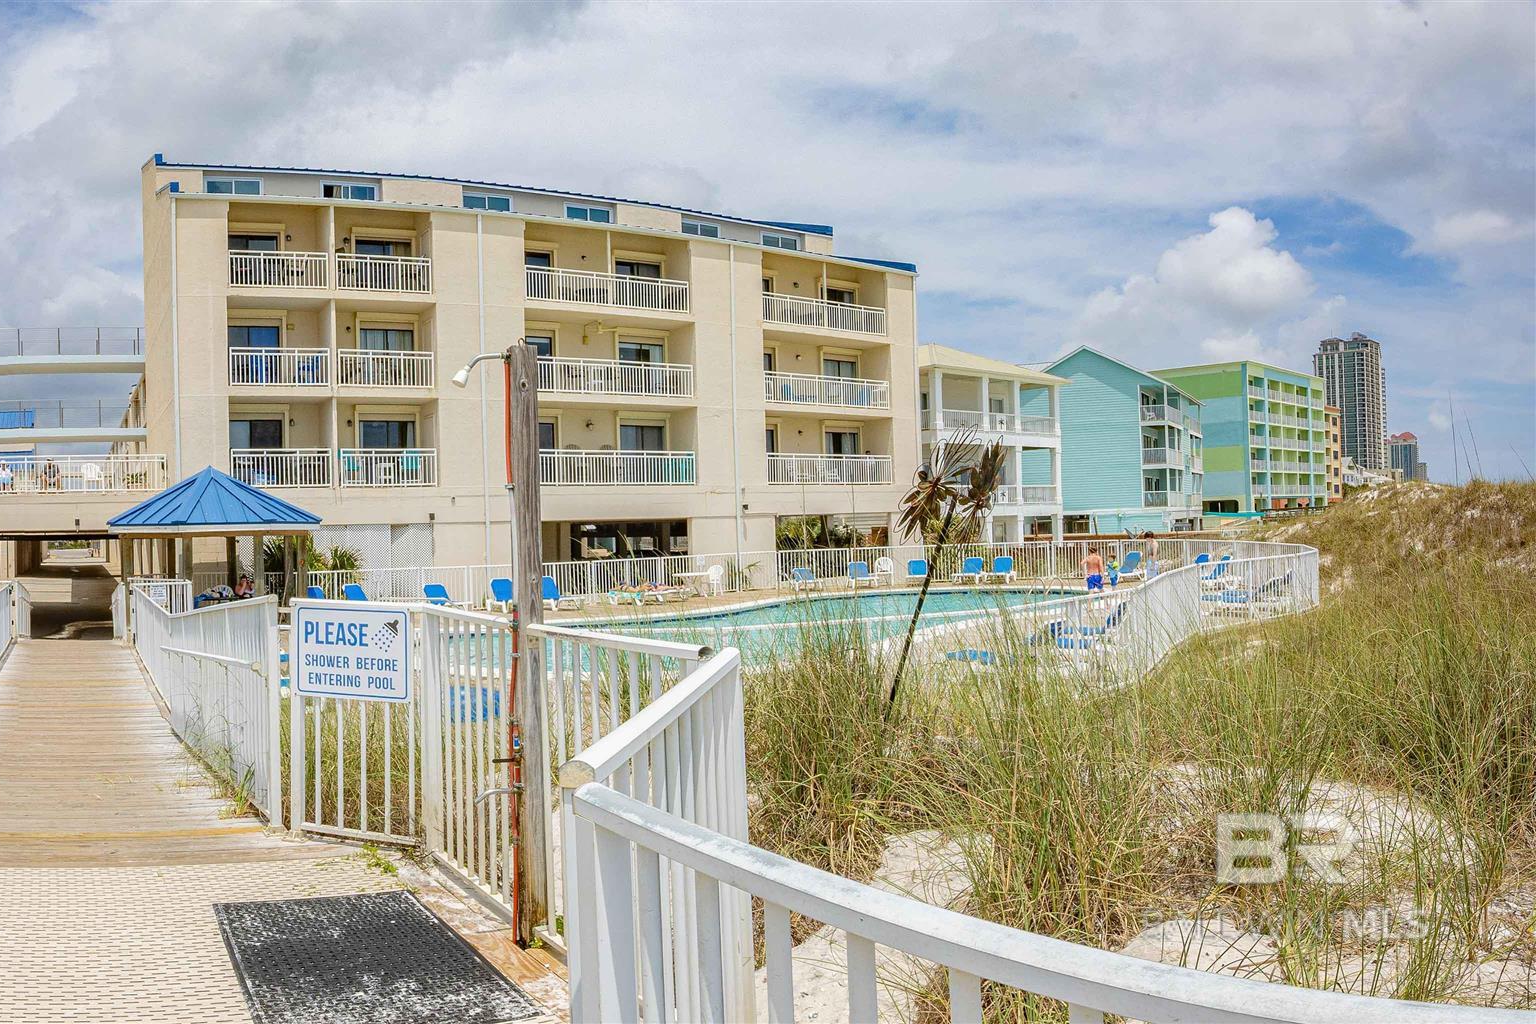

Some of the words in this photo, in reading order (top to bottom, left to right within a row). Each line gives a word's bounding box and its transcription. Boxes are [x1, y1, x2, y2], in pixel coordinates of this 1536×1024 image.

[304, 620, 369, 647] PLEASE
[305, 653, 350, 669] SHOWER
[356, 657, 398, 672] BEFORE
[308, 672, 361, 688] ENTERING
[367, 676, 396, 690] POOL
